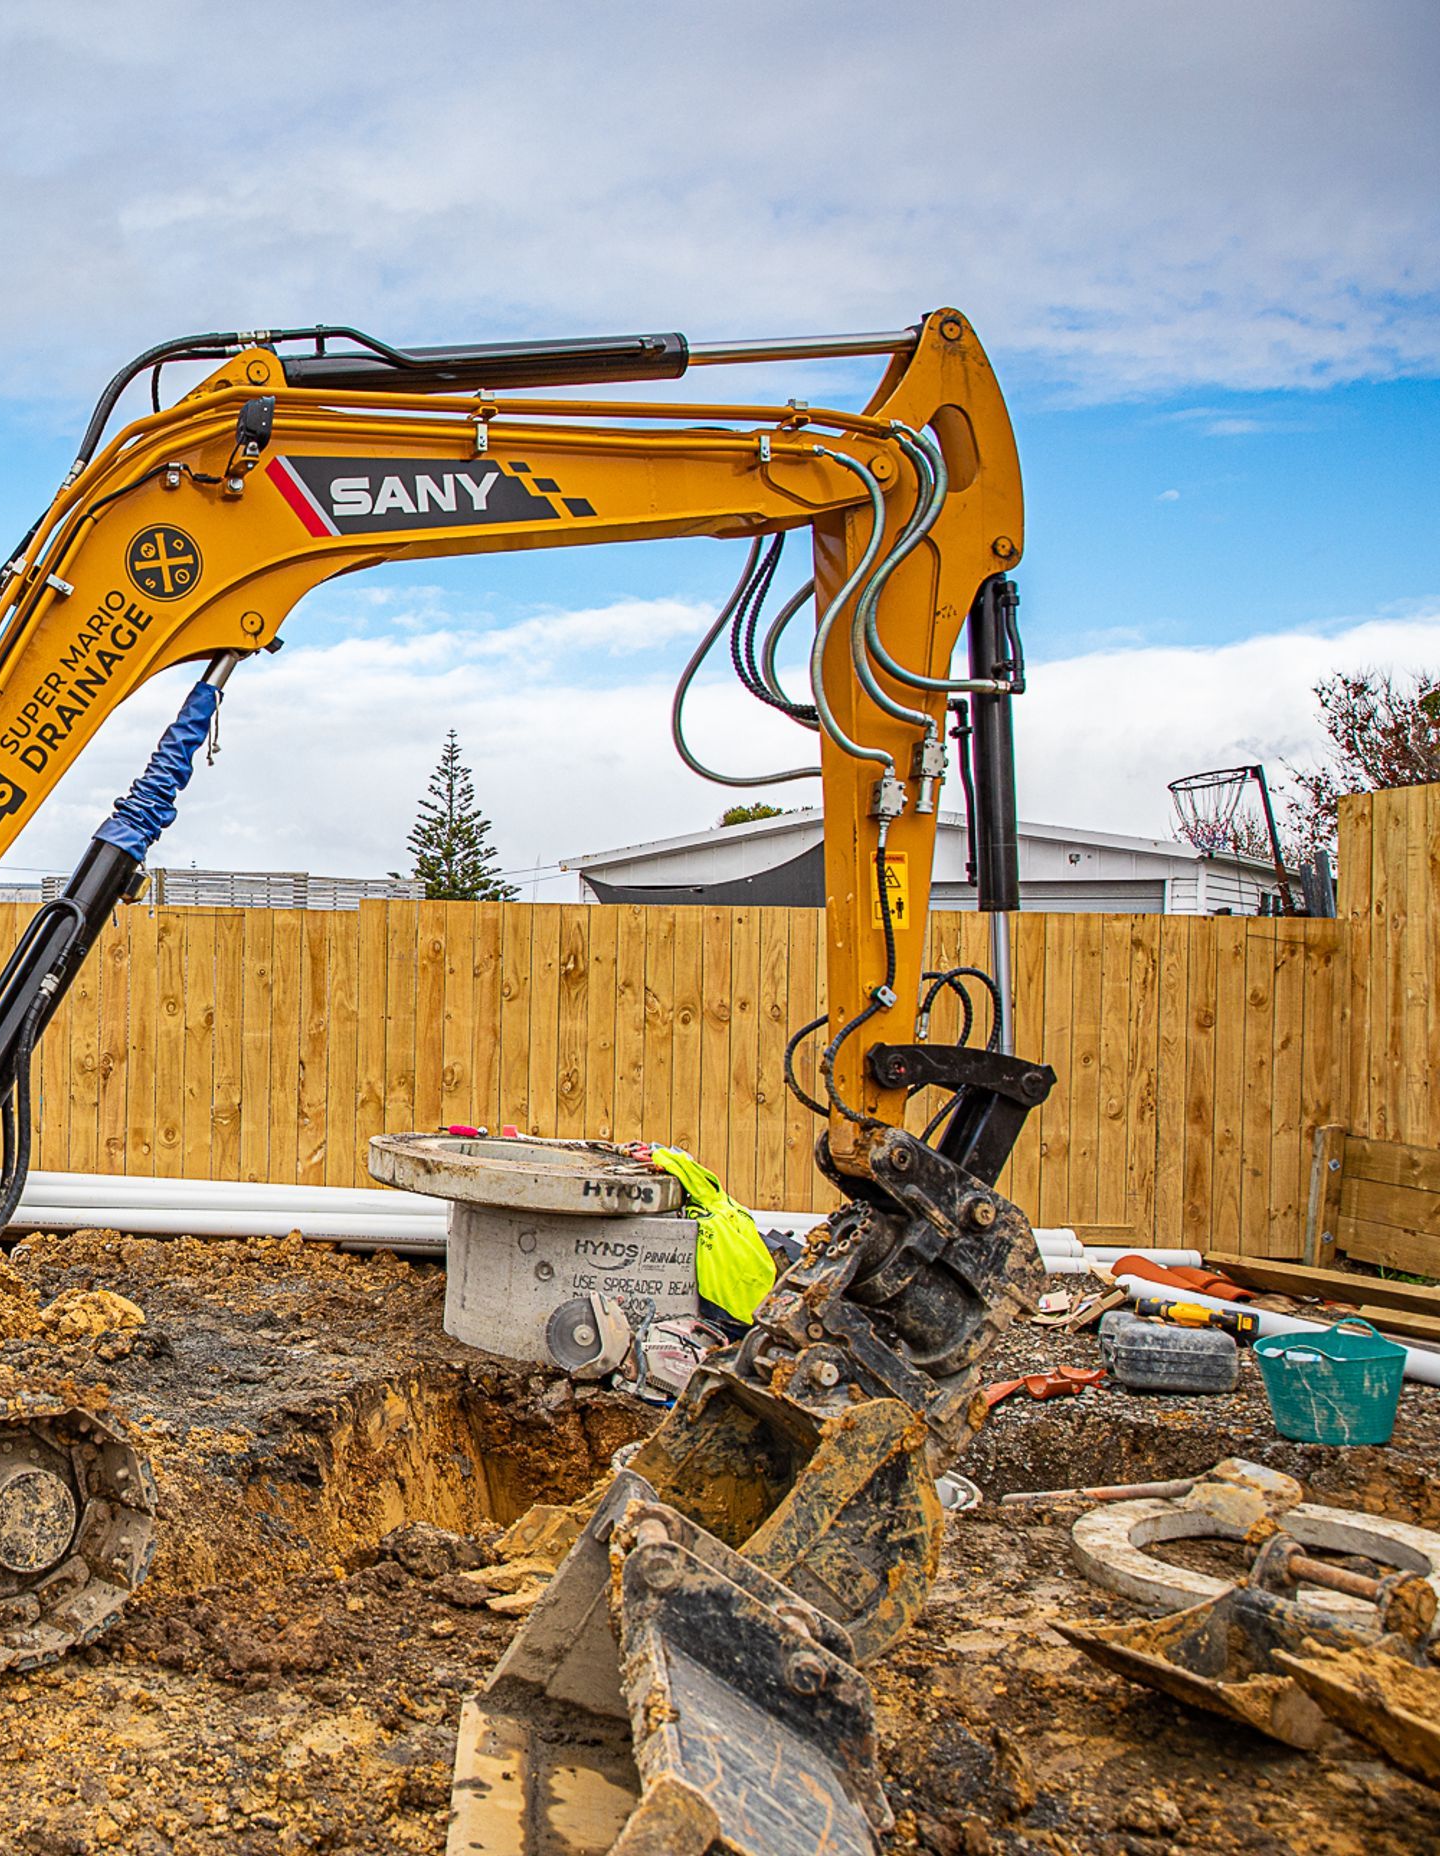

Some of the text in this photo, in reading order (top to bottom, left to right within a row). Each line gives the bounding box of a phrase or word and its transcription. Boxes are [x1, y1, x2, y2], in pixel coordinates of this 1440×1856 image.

[330, 472, 500, 516] SANY
[172, 538, 184, 551] D
[144, 577, 157, 589] S
[0, 590, 126, 755] SUPER MARIO
[19, 602, 154, 774] DRAINAGE
[574, 1239, 639, 1258] HYNDS
[572, 1274, 597, 1290] USE
[603, 1277, 664, 1295] SPREADER
[668, 1281, 696, 1296] BEAM
